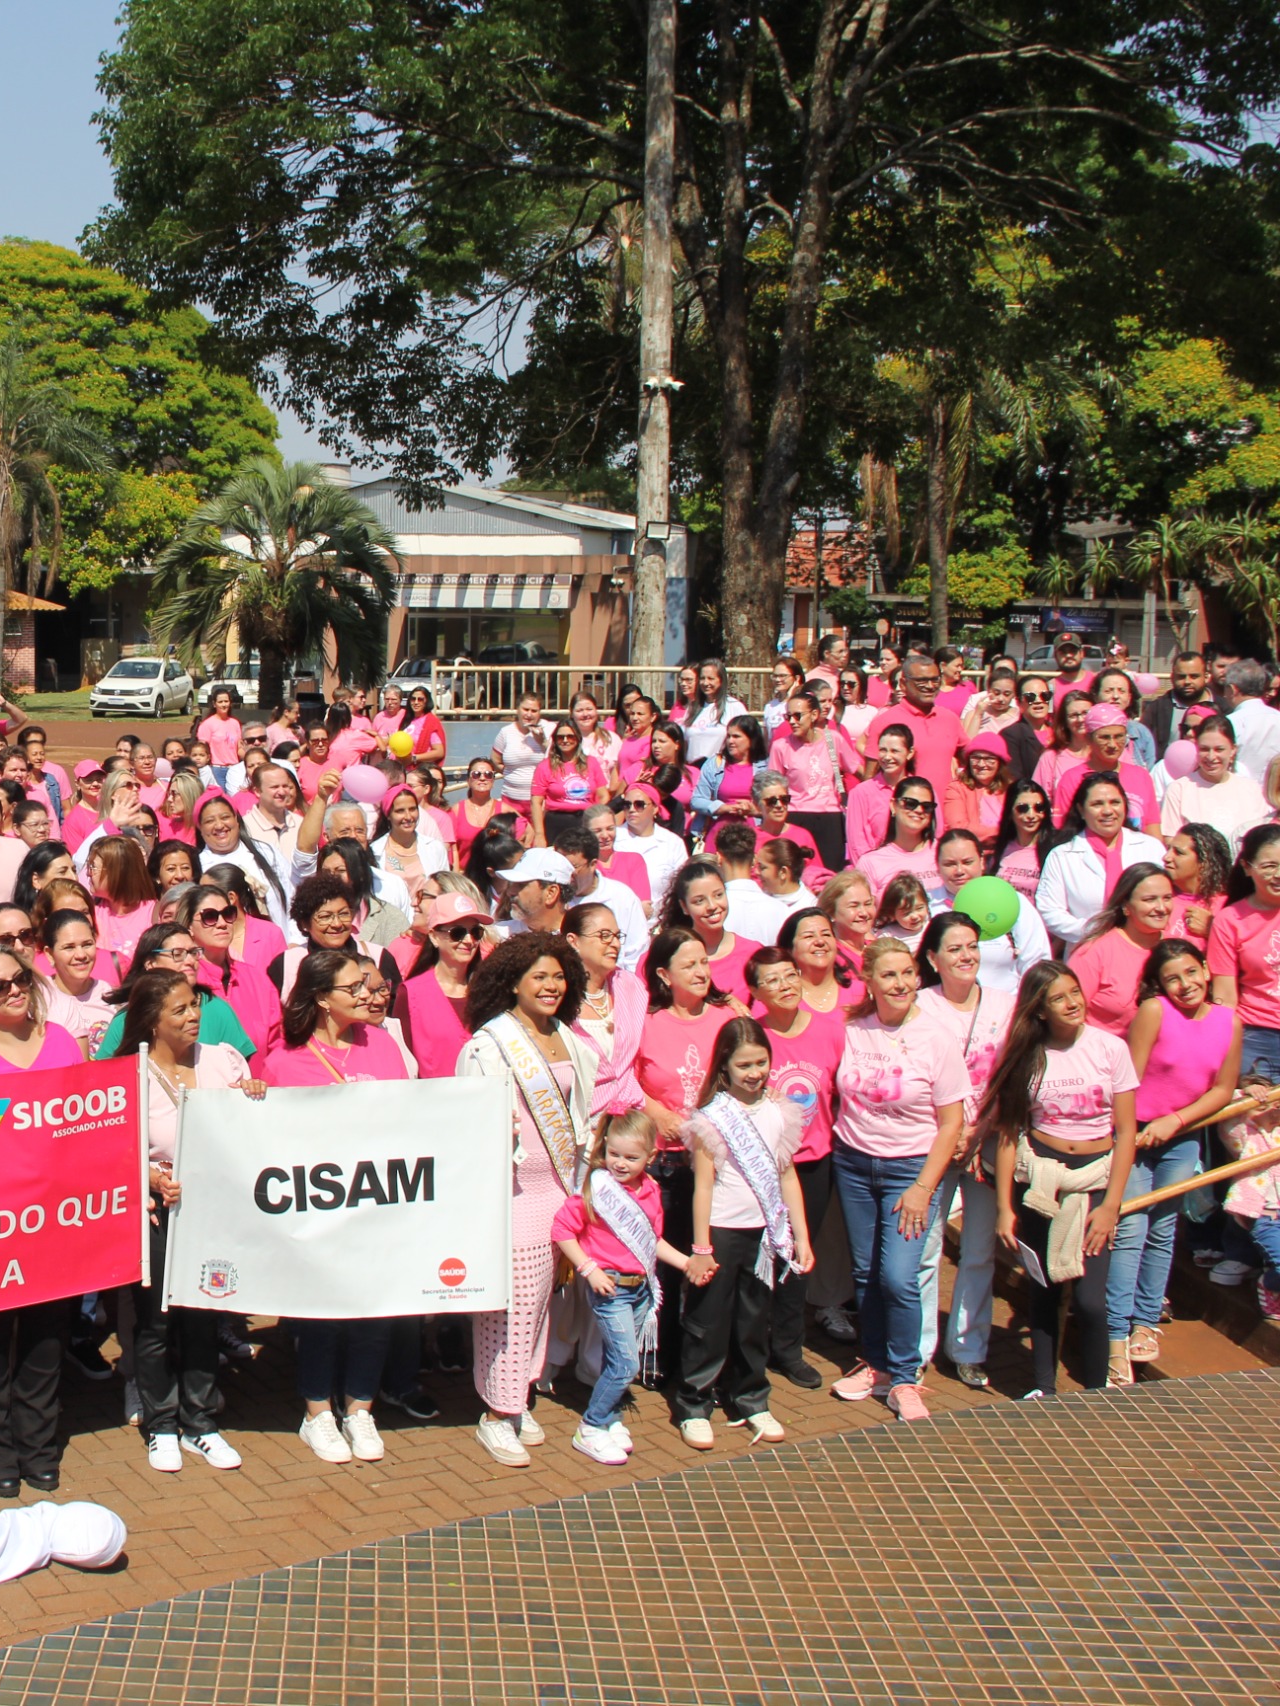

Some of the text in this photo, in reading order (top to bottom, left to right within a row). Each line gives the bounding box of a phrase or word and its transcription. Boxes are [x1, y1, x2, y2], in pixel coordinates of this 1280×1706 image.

[412, 576, 501, 585] MONITORAMENTO
[503, 576, 559, 585] MUNICIPAL
[507, 1039, 539, 1080] MISS
[12, 1085, 127, 1130] SICOOB
[52, 1122, 96, 1139] ASSOCIADO
[96, 1120, 104, 1128] A
[253, 1156, 435, 1215] CISAM
[596, 1184, 620, 1211] MISS
[57, 1185, 128, 1228] QUE
